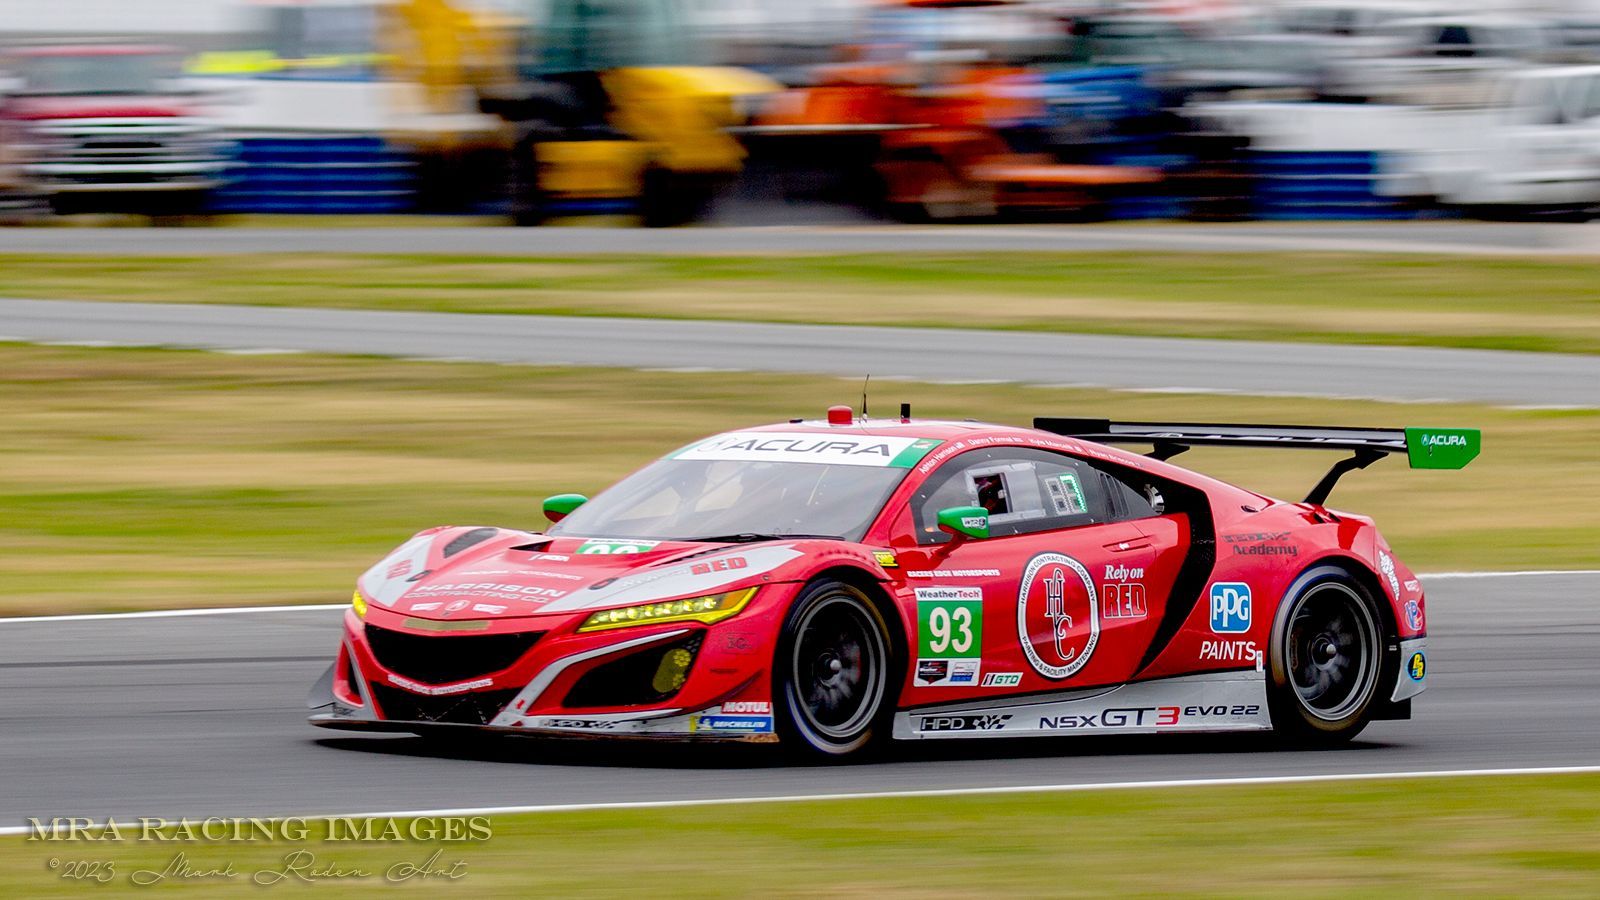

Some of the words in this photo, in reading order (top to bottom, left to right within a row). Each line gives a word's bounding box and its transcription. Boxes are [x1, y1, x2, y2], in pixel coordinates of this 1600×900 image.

[727, 439, 890, 456] ACURA
[1429, 435, 1467, 446] ACURA
[1233, 545, 1297, 556] Academy
[690, 557, 748, 575] RED
[1104, 564, 1130, 582] Rely
[1130, 567, 1144, 578] on
[1033, 555, 1076, 568] CONTRACTING
[1076, 565, 1095, 602] COMPANY
[414, 583, 567, 597] HARRISON
[919, 590, 979, 598] WeatherTech
[1103, 583, 1147, 618] RED
[1213, 588, 1249, 627] PPG
[929, 606, 973, 653] 93
[1022, 635, 1040, 667] PAINTING
[1043, 666, 1066, 676] FACILITY
[1066, 633, 1096, 674] MAINTENANCE
[1199, 641, 1257, 660] PAINTS
[995, 674, 1019, 684] GTD
[723, 702, 770, 713] MOTUL
[1184, 706, 1228, 716] EVO
[1230, 705, 1260, 715] 22
[922, 718, 966, 731] HPD
